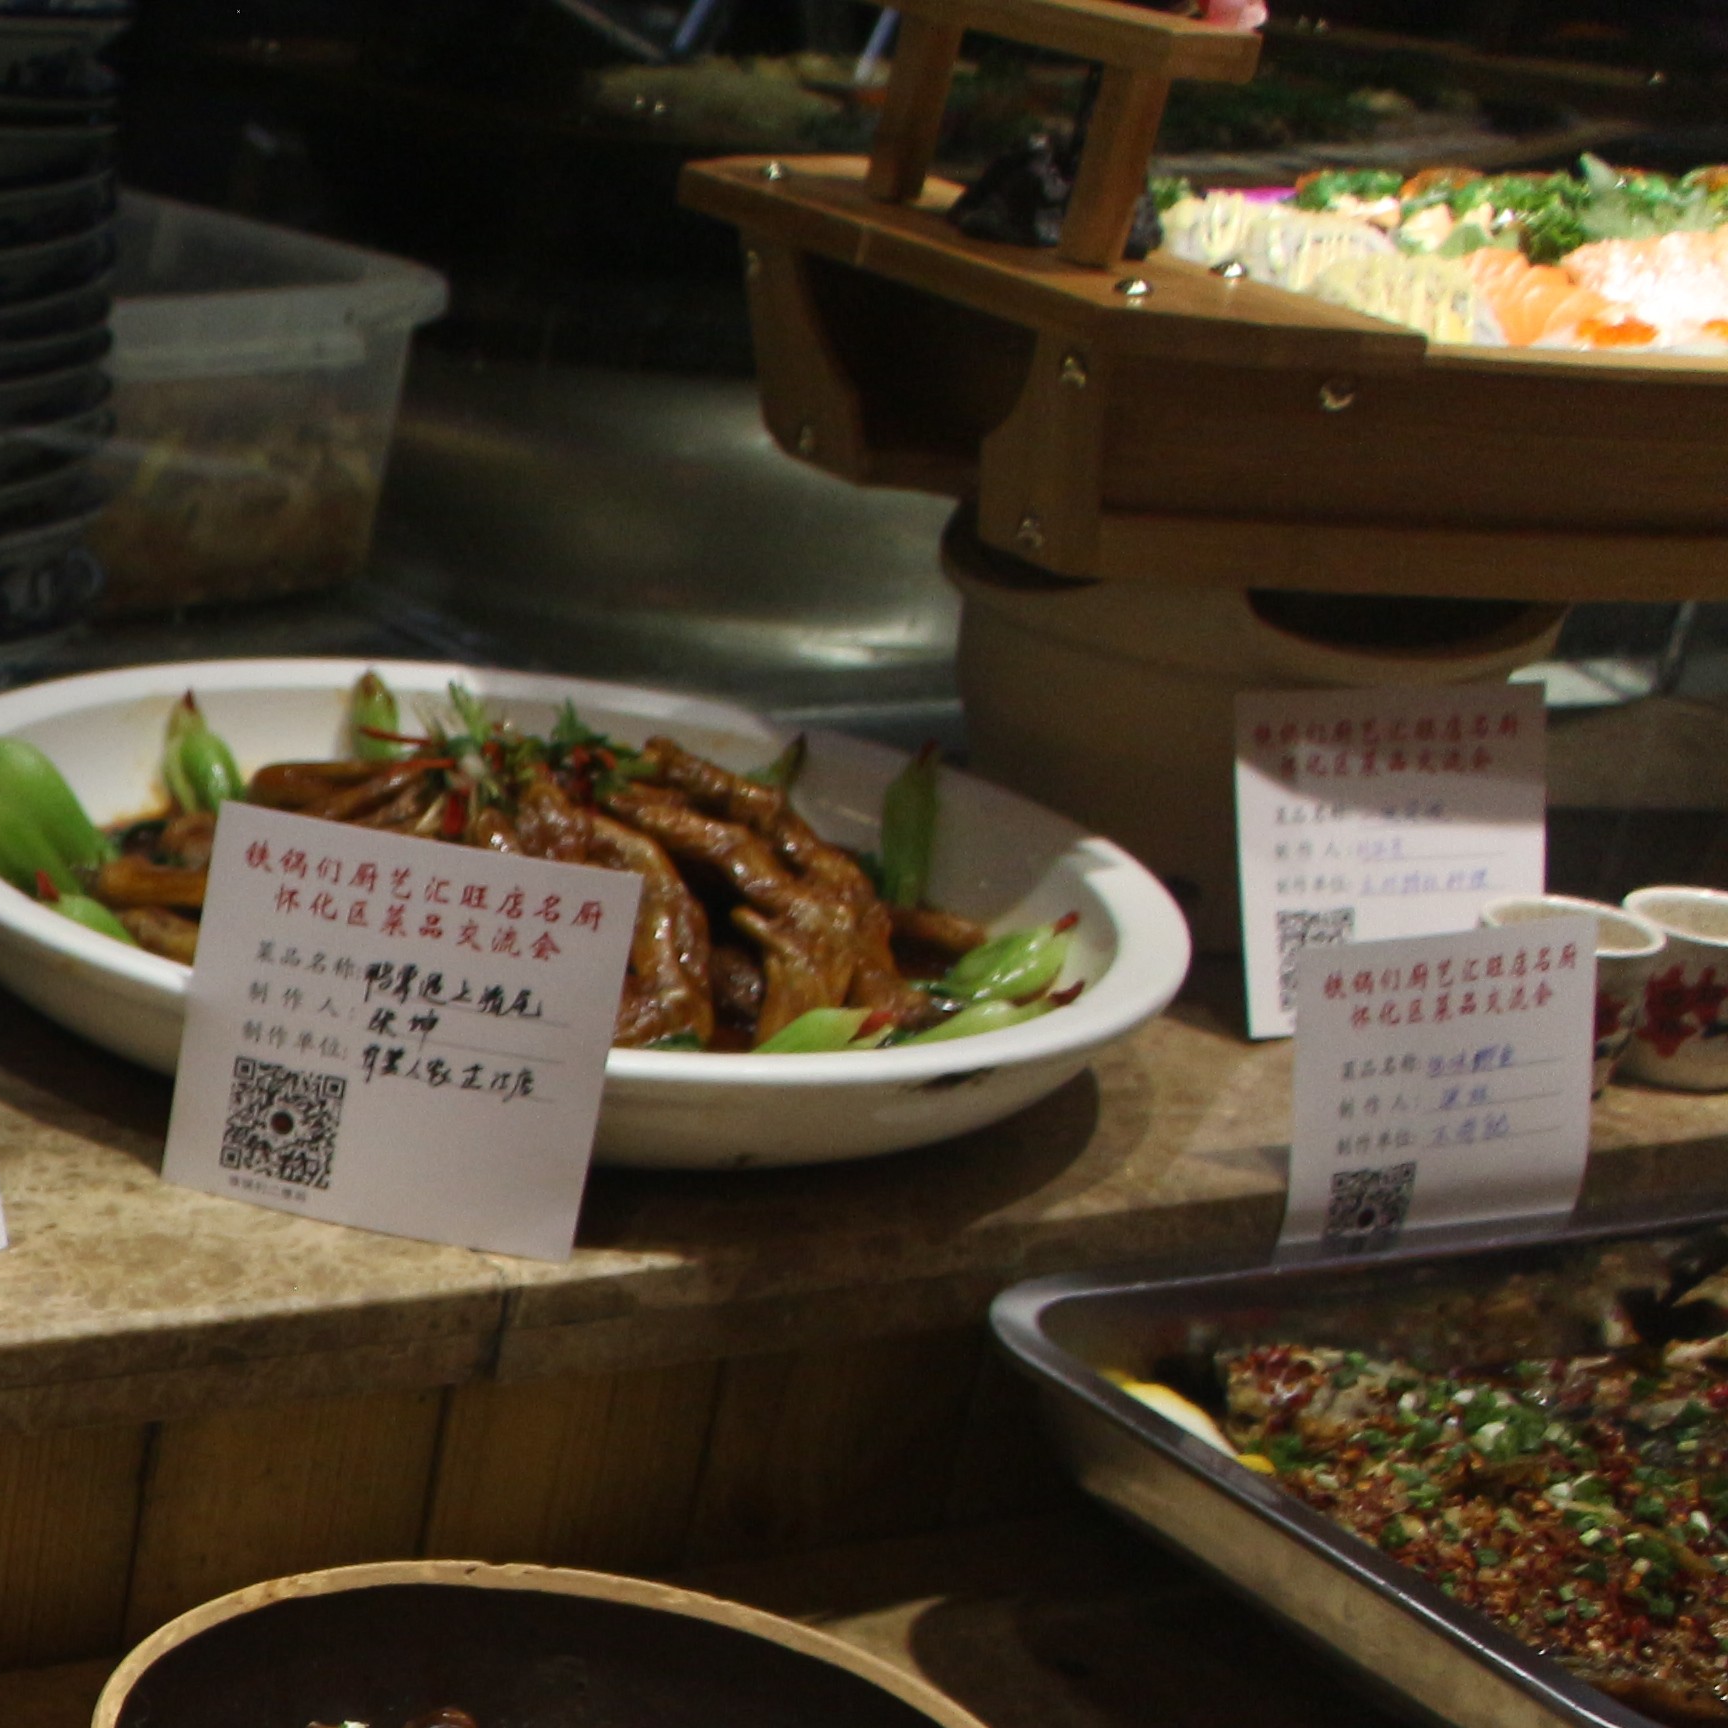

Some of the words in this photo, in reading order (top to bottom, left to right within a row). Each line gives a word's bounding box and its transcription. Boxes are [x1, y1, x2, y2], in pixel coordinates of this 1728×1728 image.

[245, 839, 603, 932] 铁锅们厨艺汇旺店名厨
[273, 883, 561, 961] 怀化区菜品交流会
